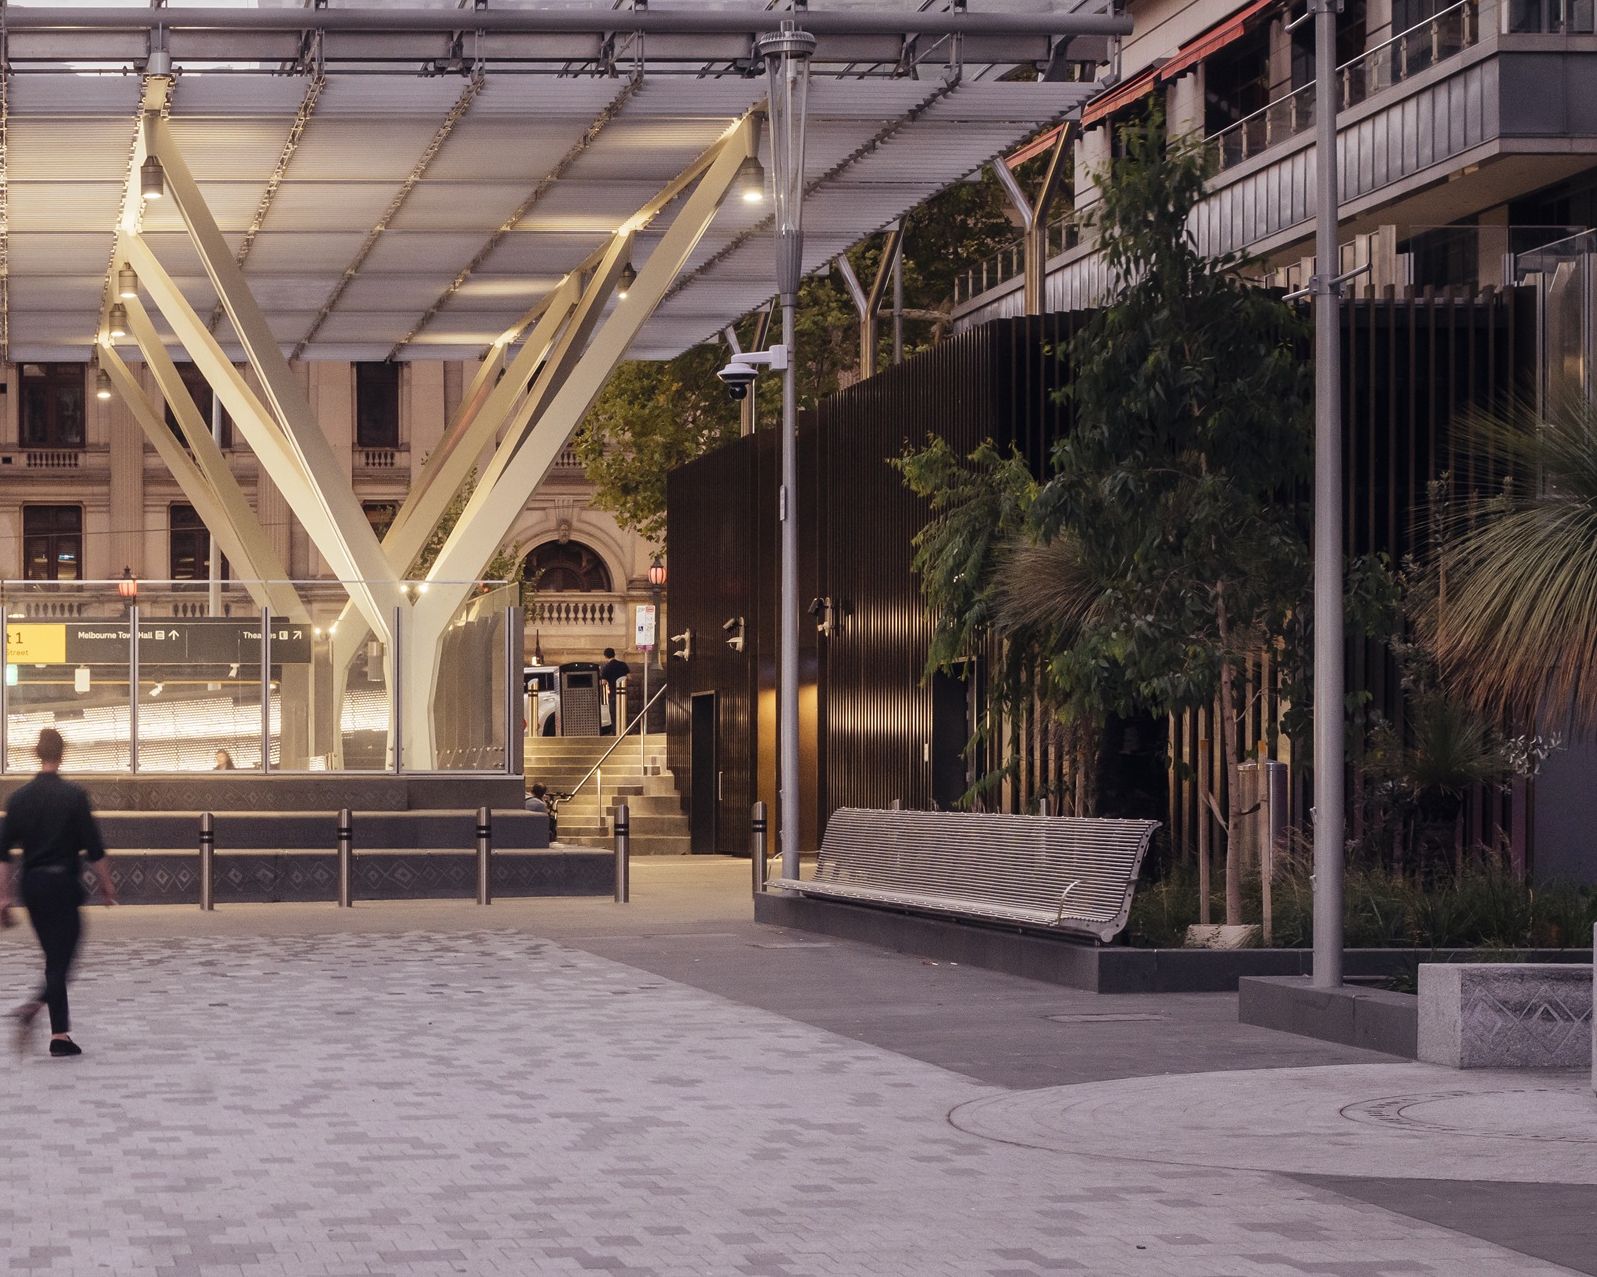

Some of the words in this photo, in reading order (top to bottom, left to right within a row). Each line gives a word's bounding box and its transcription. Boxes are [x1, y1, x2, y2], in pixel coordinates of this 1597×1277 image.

[15, 632, 24, 644] 1
[78, 631, 117, 639] Melbourne
[118, 631, 131, 639] Tow
[138, 631, 153, 639] Hall
